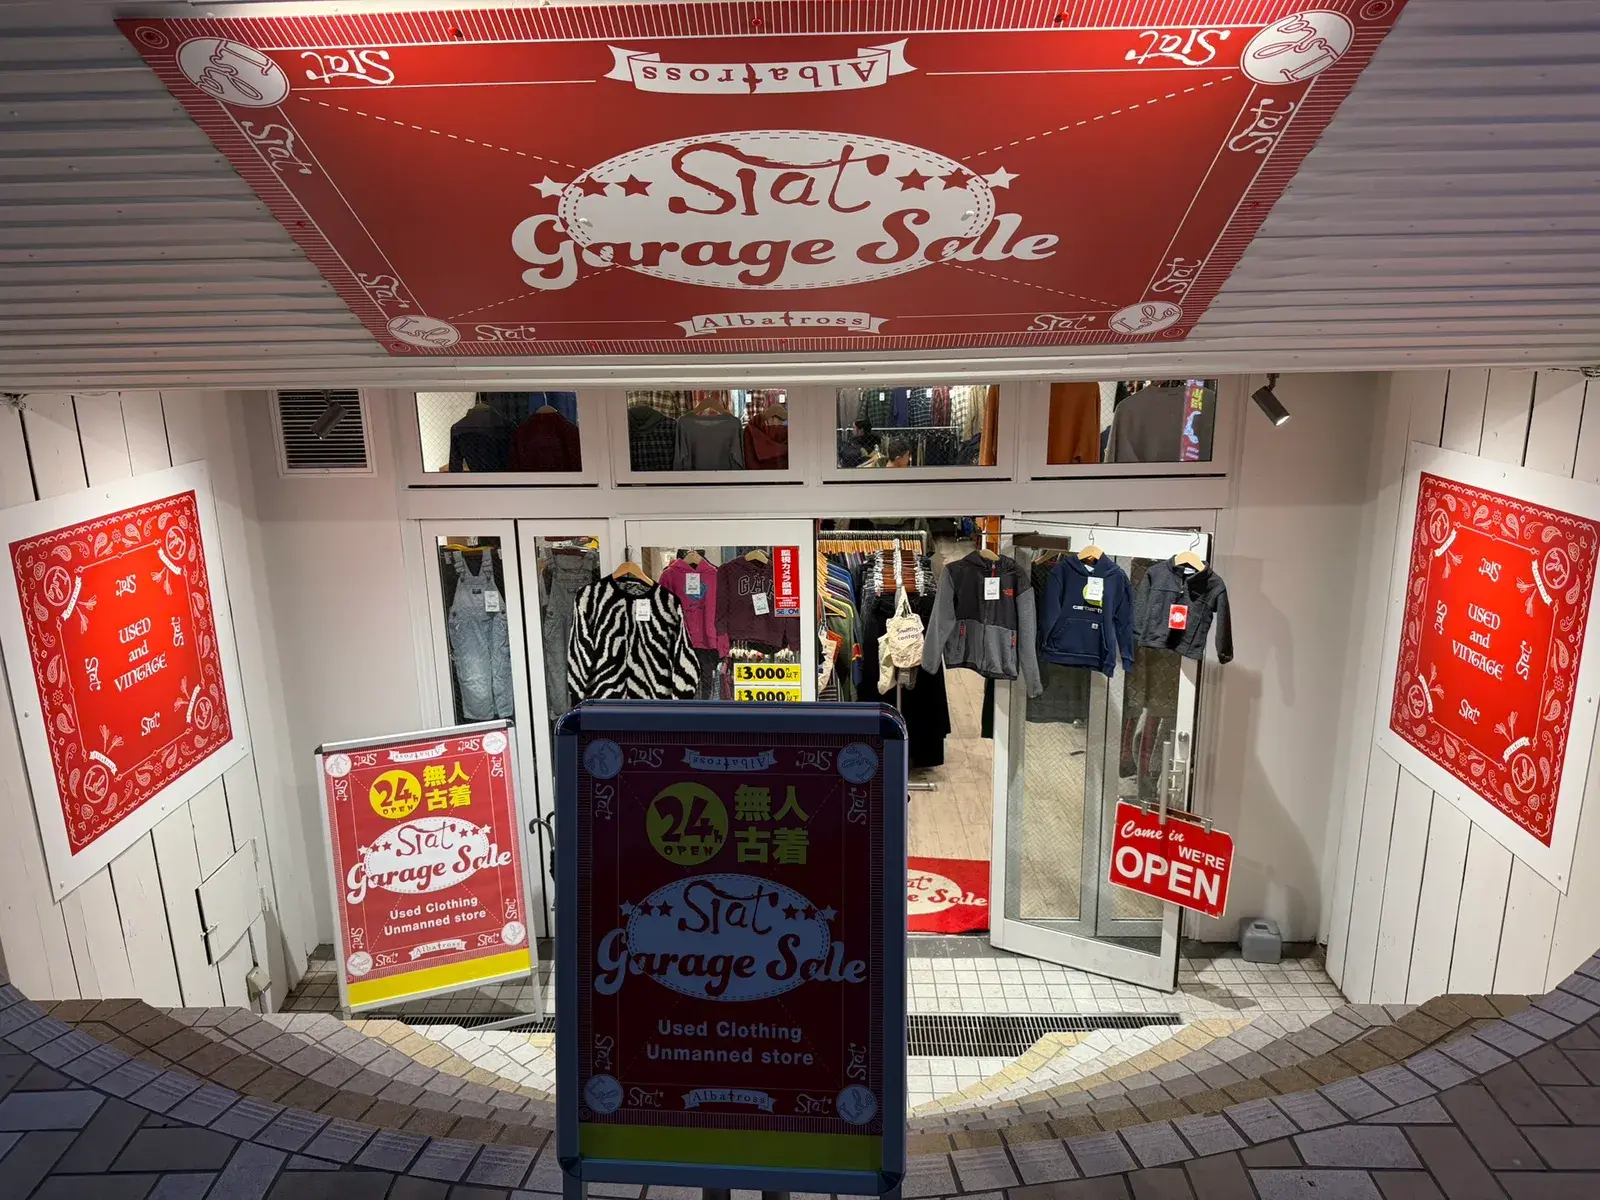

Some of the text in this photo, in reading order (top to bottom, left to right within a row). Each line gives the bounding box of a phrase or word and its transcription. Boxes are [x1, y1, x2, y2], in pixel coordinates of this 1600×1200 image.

[641, 57, 872, 93] Albatross
[511, 208, 1059, 290] Garage Sale
[701, 310, 863, 330] Albatross
[1468, 603, 1500, 631] USED
[119, 617, 151, 644] USED
[1469, 631, 1490, 649] and
[128, 641, 150, 663] and
[1451, 640, 1505, 681] VINTAGE
[113, 654, 168, 692] VINTAGE
[423, 761, 470, 786] 無人
[691, 752, 767, 771] Albatross
[382, 804, 414, 815] OPEN
[426, 786, 471, 811] 古着
[734, 784, 808, 822] 無人
[1120, 820, 1185, 843] Come in
[663, 845, 714, 857] OPEN
[734, 827, 810, 865] 古着
[1178, 845, 1226, 872] WE'RE
[347, 843, 512, 905] Garage Sale
[1116, 846, 1220, 906] OPEN
[390, 896, 478, 920] Used Clothing
[928, 888, 988, 907] Sale
[384, 909, 486, 936] Unmanned store
[594, 928, 868, 996] Garage Sale
[658, 1019, 802, 1043] Used Clothing
[646, 1044, 814, 1066] Unmanned store
[692, 1090, 765, 1105] Albatross
